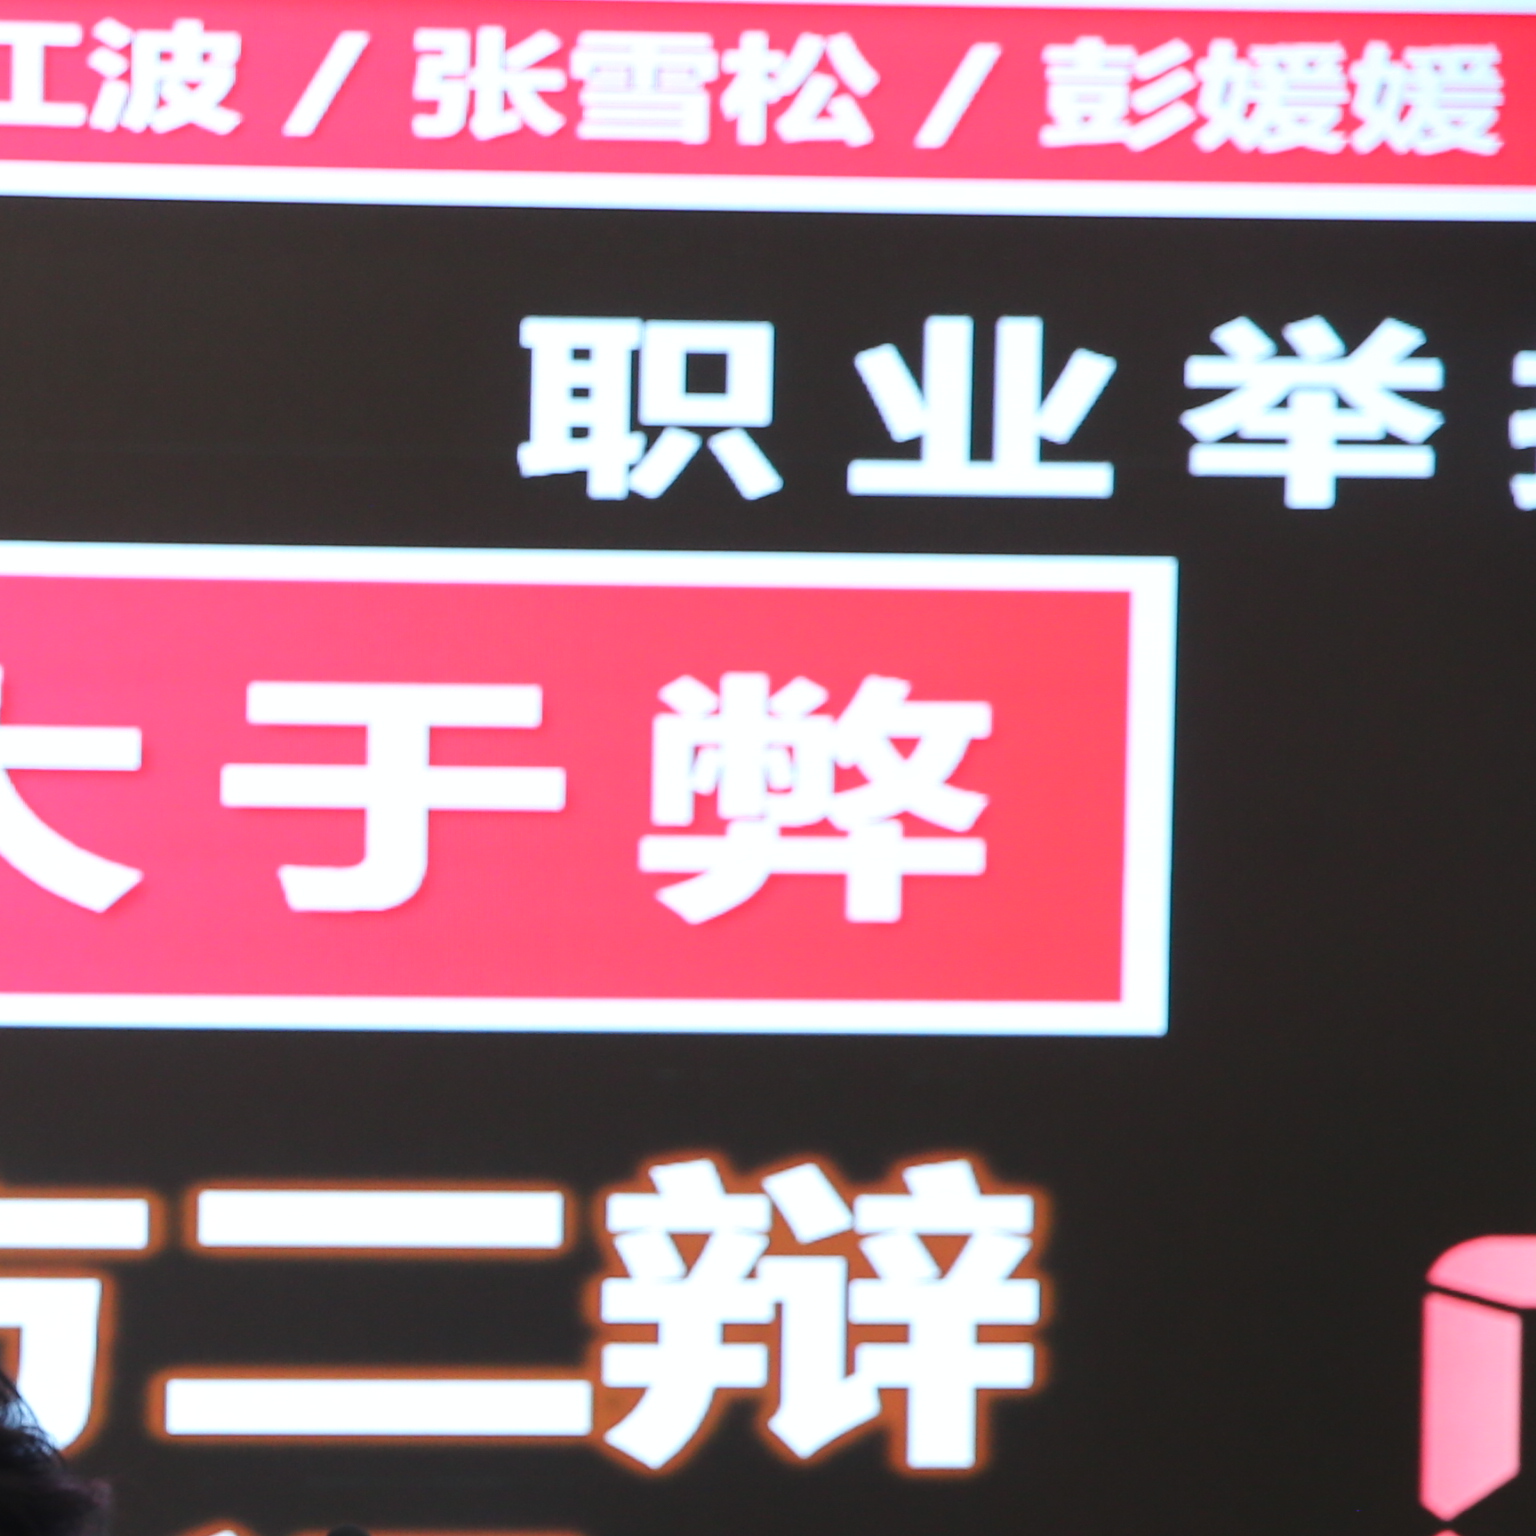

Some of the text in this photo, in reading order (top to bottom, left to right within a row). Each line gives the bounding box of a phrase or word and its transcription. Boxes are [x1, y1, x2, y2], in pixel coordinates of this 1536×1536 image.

[281, 29, 372, 138] /
[410, 25, 880, 148] 张雪松
[913, 41, 1003, 150] /
[1038, 37, 1505, 156] 彭媛媛
[516, 314, 1536, 510] 职业举
